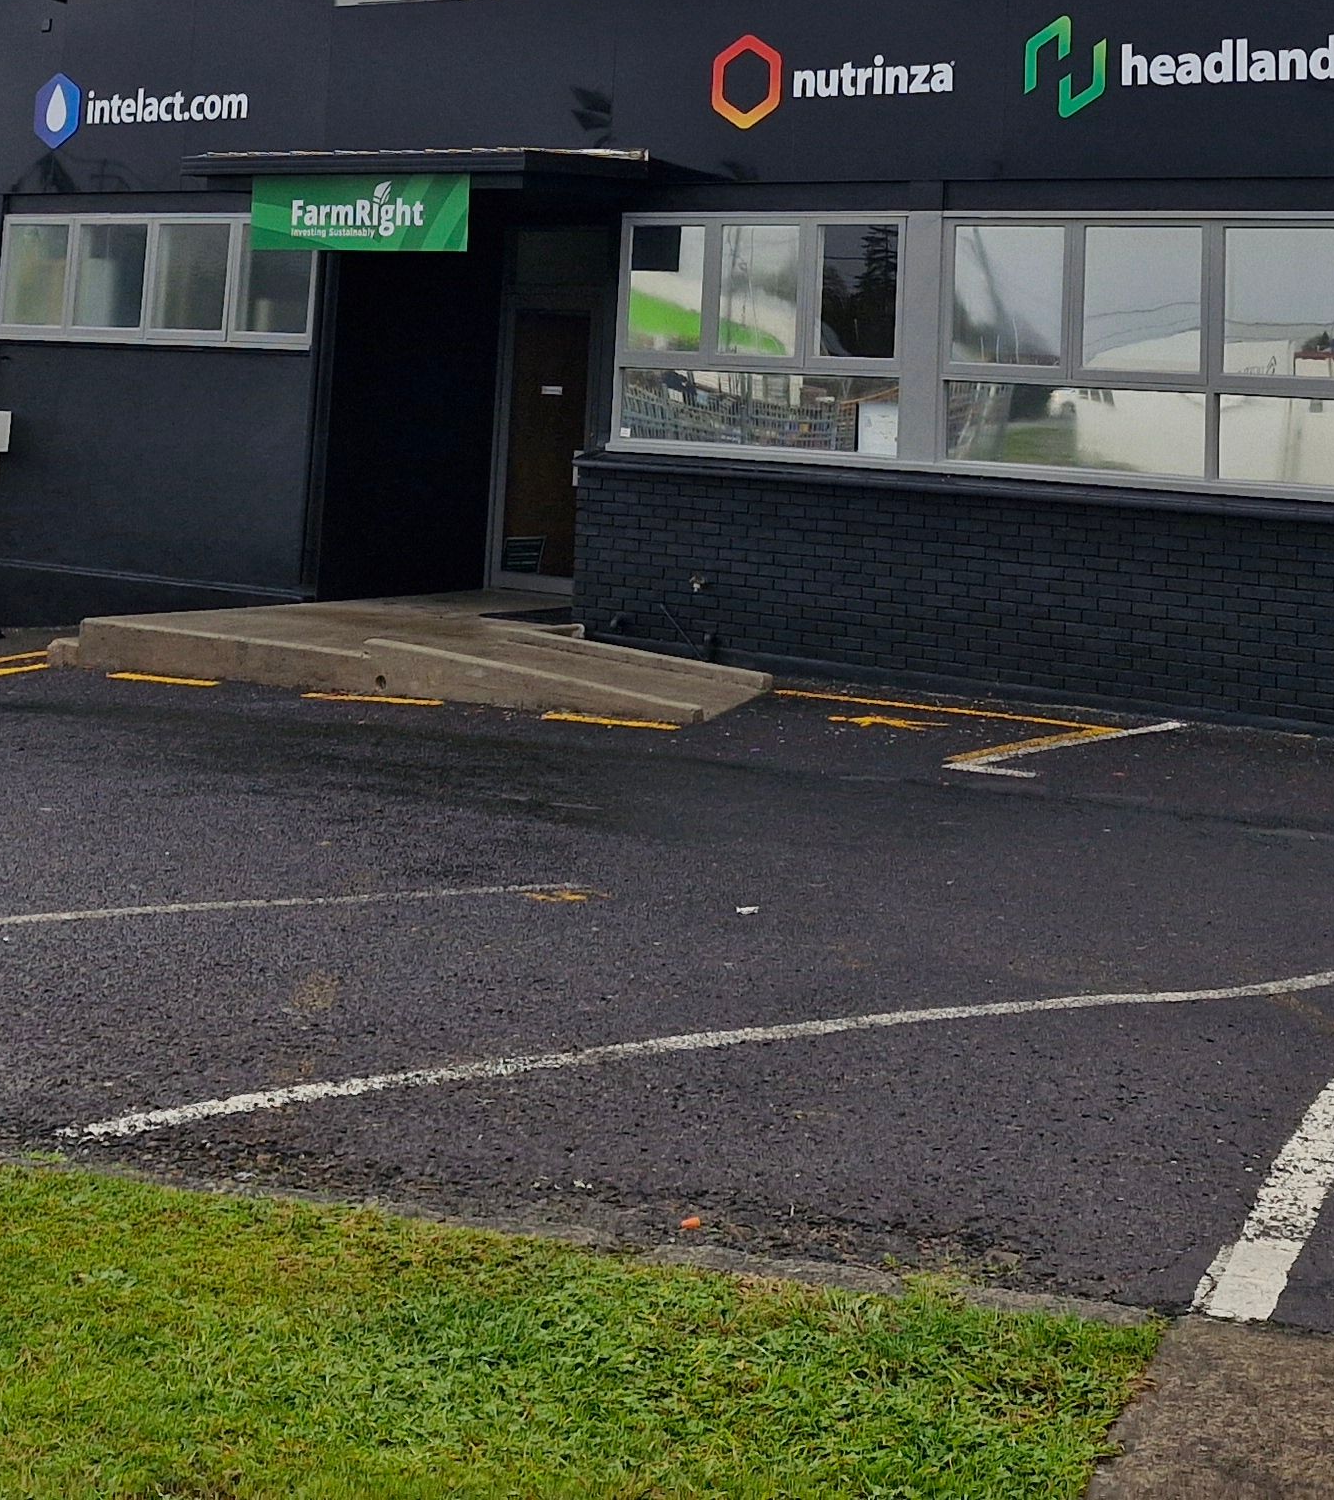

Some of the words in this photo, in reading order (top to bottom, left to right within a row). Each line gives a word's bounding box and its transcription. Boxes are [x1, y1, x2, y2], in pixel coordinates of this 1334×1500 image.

[793, 54, 954, 98] nutrinza
[86, 87, 249, 125] intelact.com
[291, 197, 424, 237] FarmRight
[291, 227, 327, 238] Investing
[328, 227, 376, 239] Sustainably
